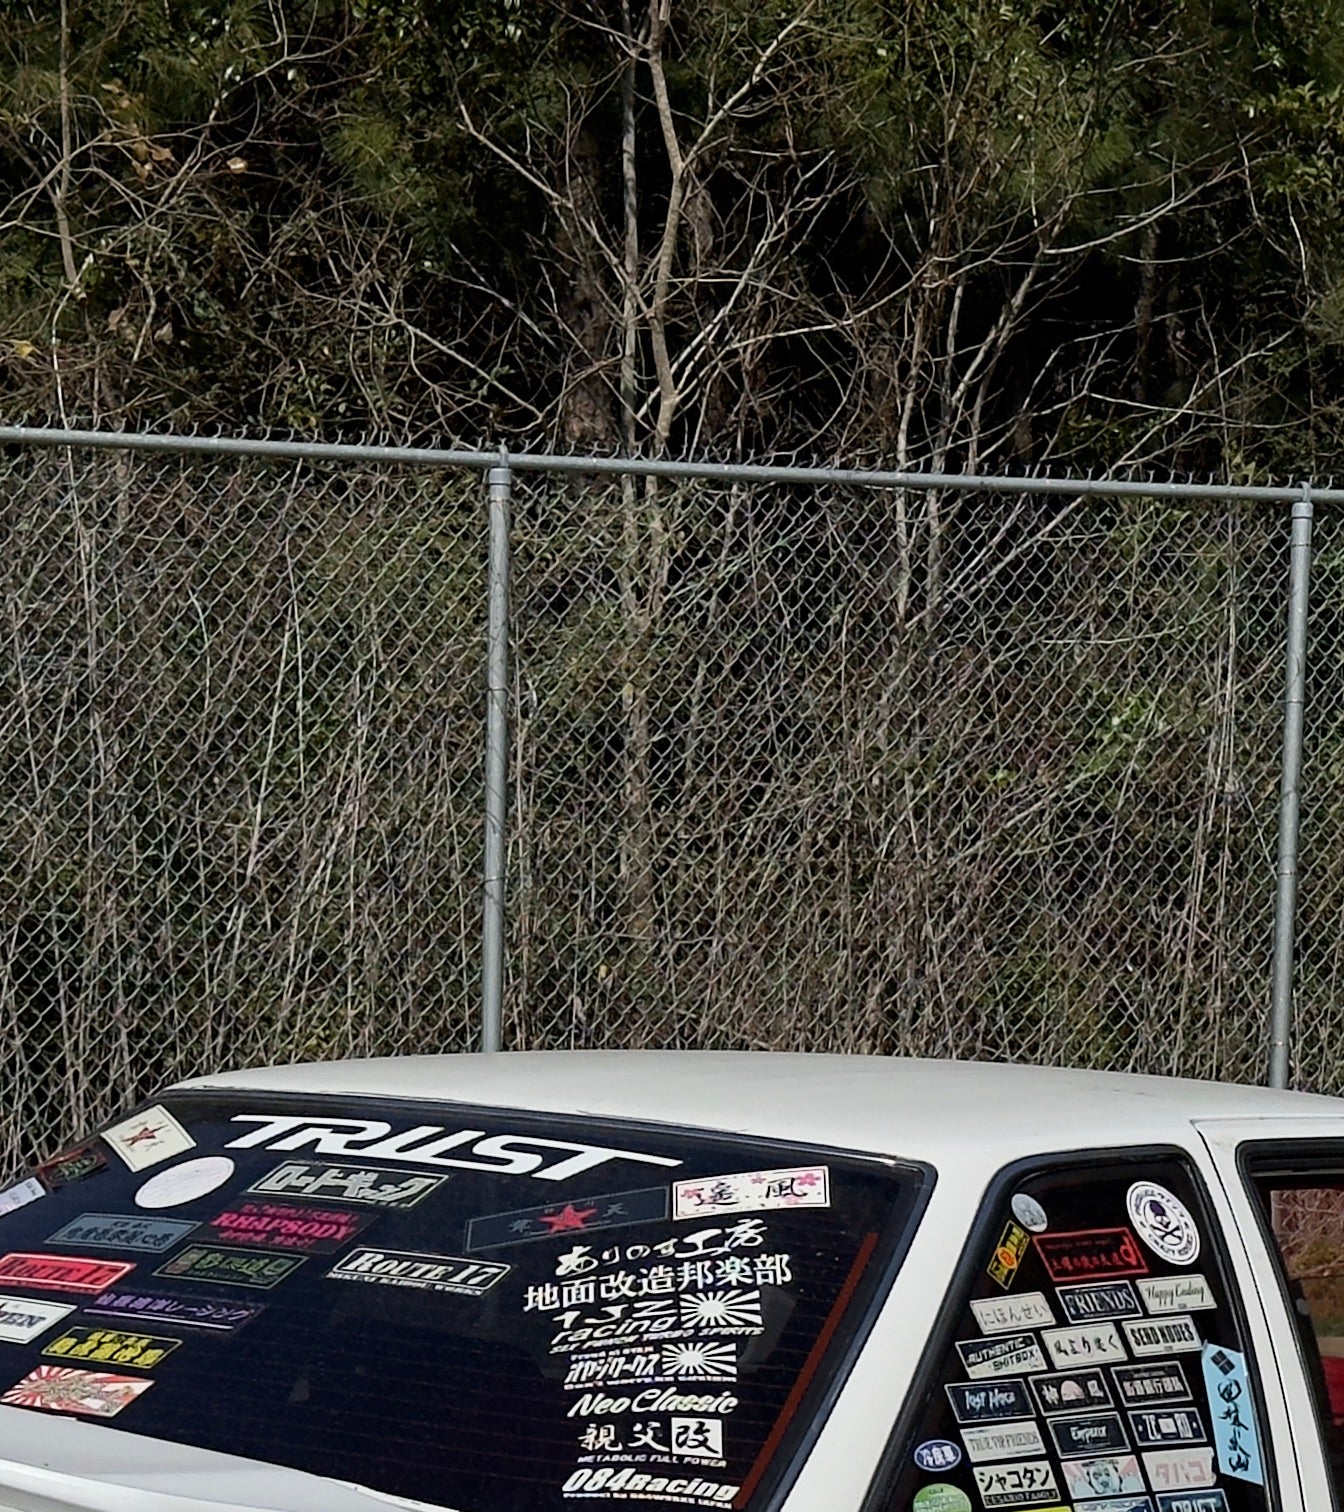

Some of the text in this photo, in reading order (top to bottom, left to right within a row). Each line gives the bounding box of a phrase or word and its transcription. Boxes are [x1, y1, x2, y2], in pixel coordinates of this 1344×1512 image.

[224, 1114, 684, 1181] TRUST
[210, 1211, 353, 1240] RHAPSODY
[344, 1251, 449, 1279] ROUTE
[452, 1264, 500, 1290] 17
[1064, 1286, 1136, 1316] FRIENDS
[1146, 1285, 1175, 1307] Happy
[551, 1315, 679, 1345] racing
[1129, 1326, 1159, 1348] SEND
[966, 1336, 1027, 1364] AUTHENTIC
[567, 1386, 739, 1419] Neo Classic
[649, 1454, 679, 1465] FULL
[682, 1456, 728, 1469] POWER
[978, 1465, 1052, 1493] シャコタン
